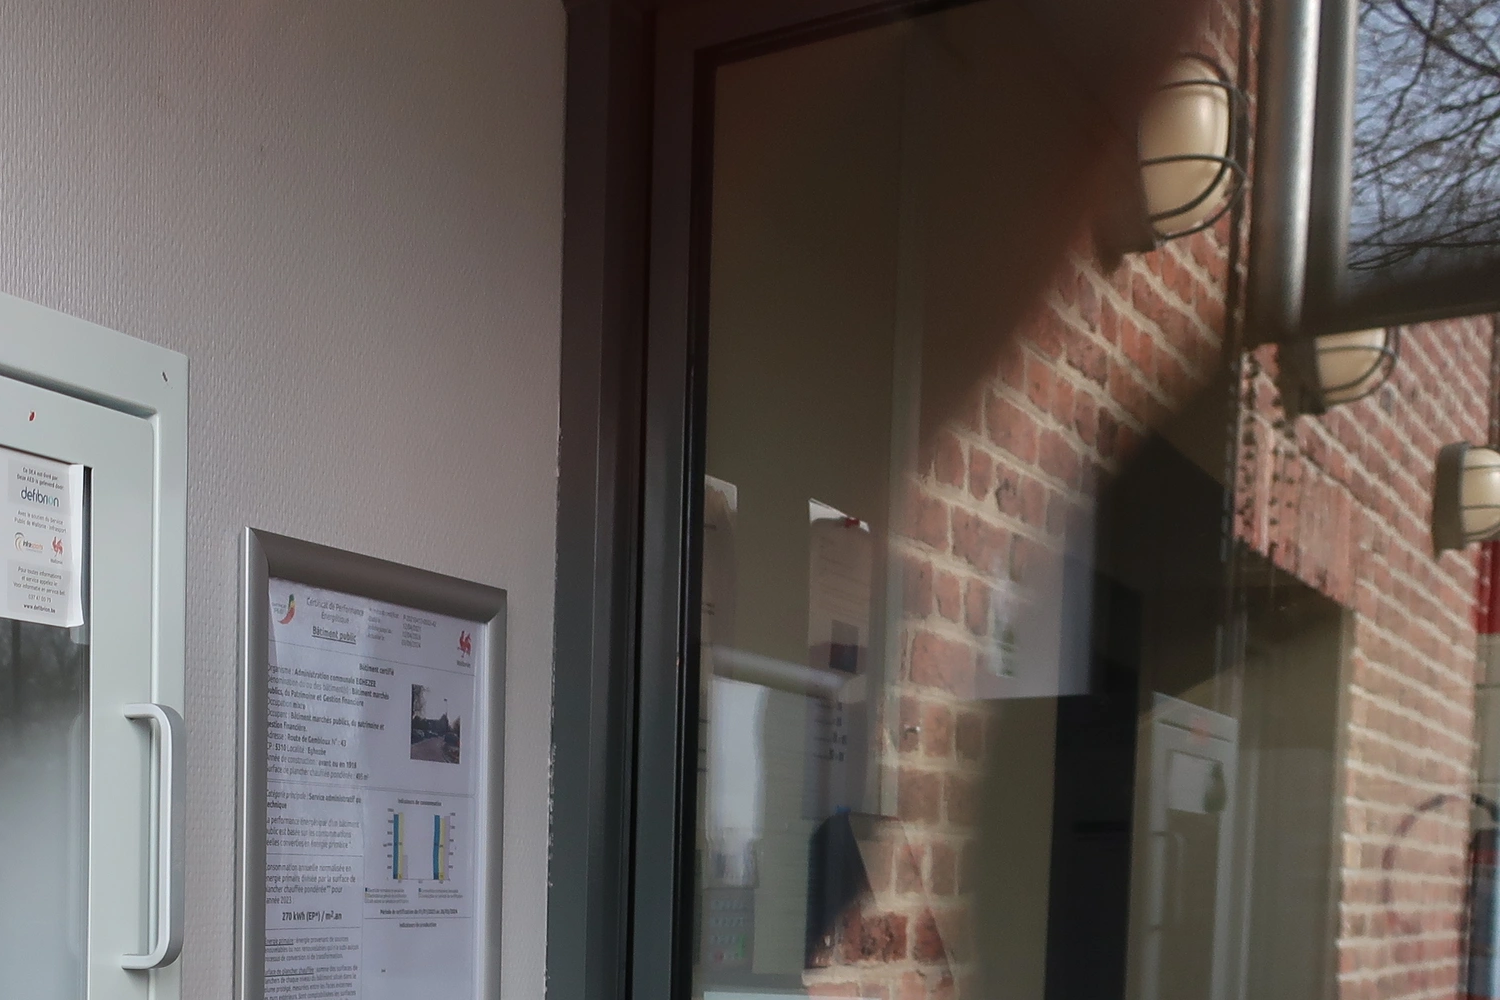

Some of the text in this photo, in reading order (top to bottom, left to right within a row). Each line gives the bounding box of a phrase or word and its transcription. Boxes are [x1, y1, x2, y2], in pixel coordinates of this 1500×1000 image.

[20, 487, 59, 506] defibrion
[312, 625, 356, 642] Bâtiment public
